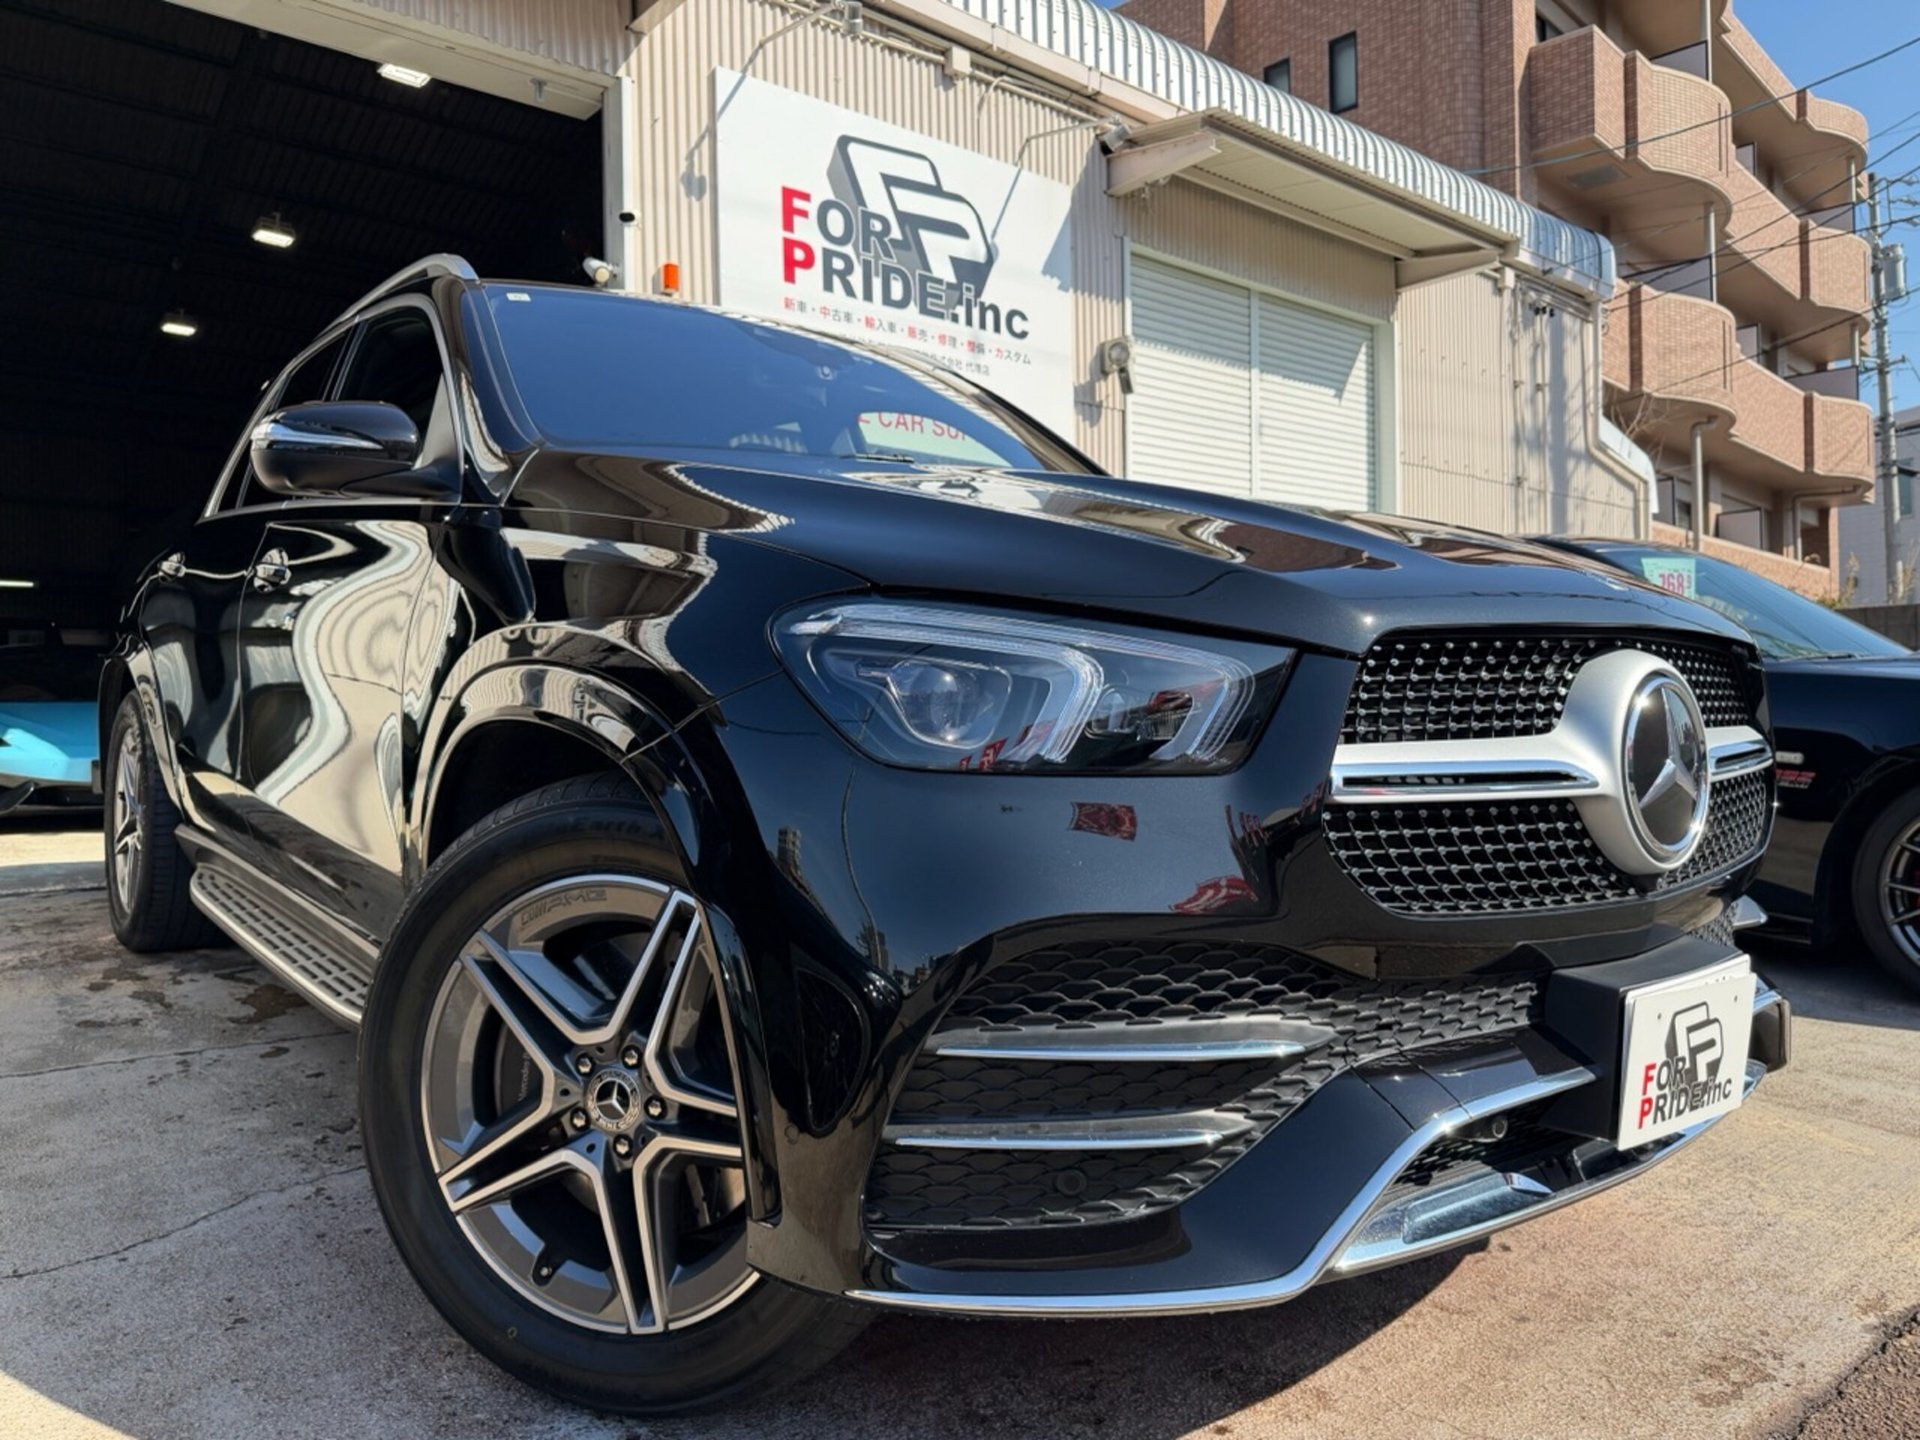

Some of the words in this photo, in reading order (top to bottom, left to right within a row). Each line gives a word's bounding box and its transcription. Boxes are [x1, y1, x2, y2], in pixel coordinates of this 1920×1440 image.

[781, 186, 897, 262] FOR
[782, 236, 1030, 340] PRIDE.inc
[878, 411, 924, 433] CAR
[1638, 1076, 1732, 1129] PRIDE.inc
[1642, 1056, 1686, 1096] FOR
